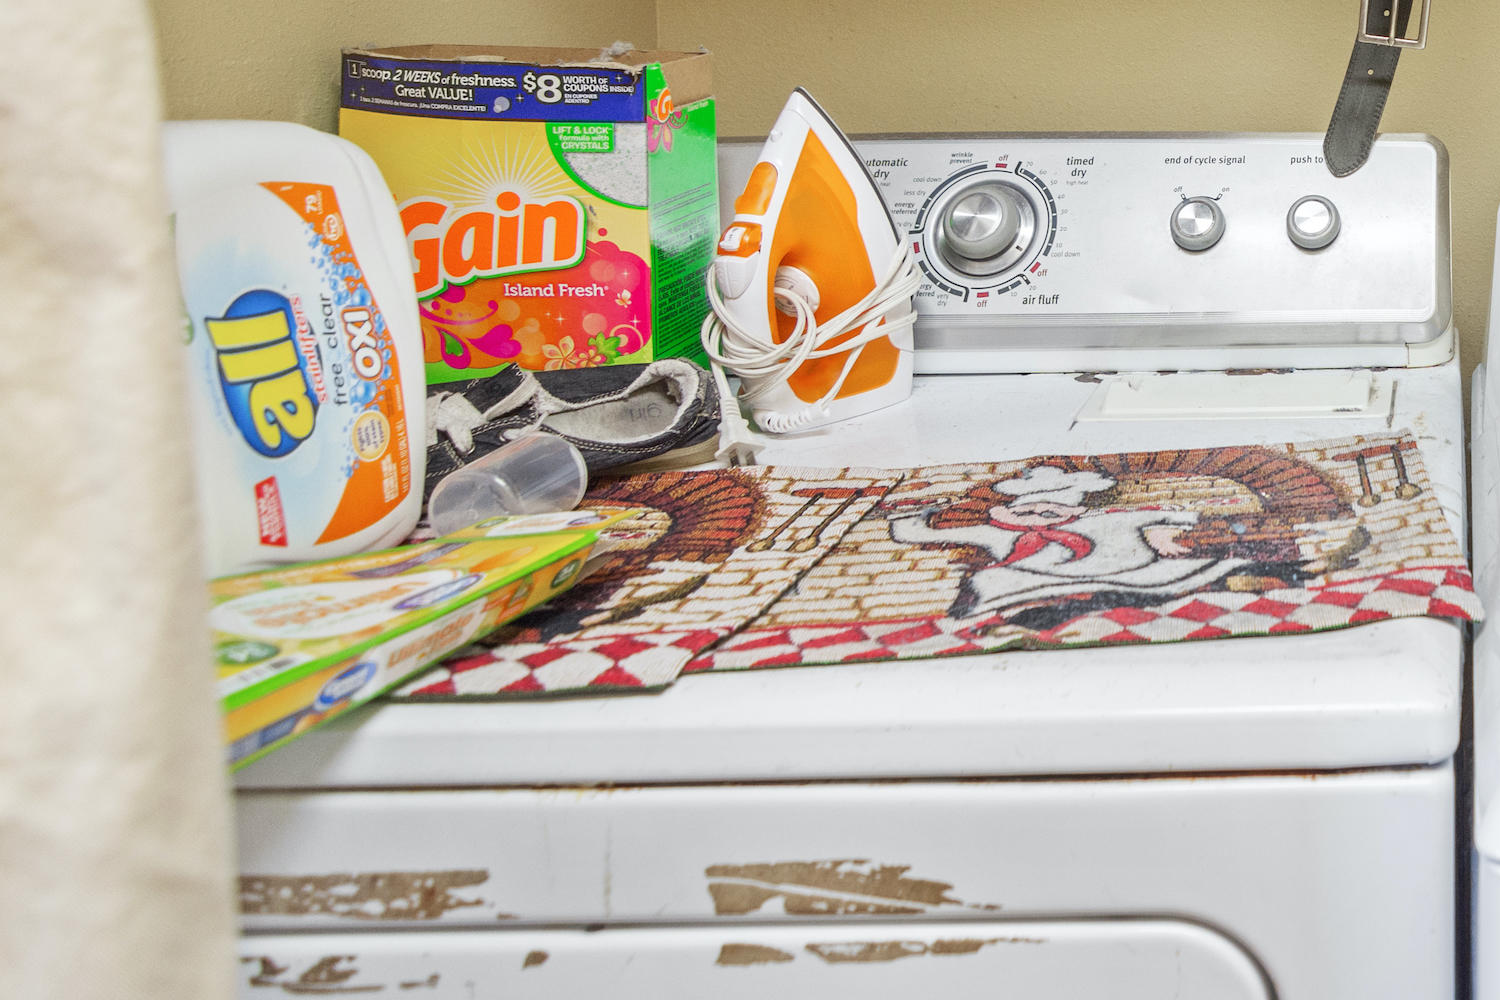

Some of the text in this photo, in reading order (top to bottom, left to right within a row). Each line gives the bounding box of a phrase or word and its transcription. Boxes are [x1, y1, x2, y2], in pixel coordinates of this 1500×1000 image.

[393, 70, 402, 81] 2
[403, 70, 442, 85] WEEKS
[441, 77, 451, 85] of
[451, 73, 518, 88] freshness.
[563, 76, 597, 85] WORTH
[395, 85, 474, 101] Great VALUE!
[563, 84, 609, 93] COUPONS
[552, 126, 572, 134] LIFT
[561, 141, 610, 150] CRYSTALS
[865, 157, 909, 167] utomatic
[950, 157, 973, 165] prevent
[998, 153, 1009, 162] off
[1066, 157, 1095, 166] timed
[1164, 155, 1246, 166] end of cycle signal
[1290, 155, 1324, 165] push to
[873, 169, 890, 180] dry
[1071, 167, 1087, 178] dry
[912, 175, 942, 183] cool down
[305, 194, 318, 214] 79
[894, 201, 915, 209] energy
[400, 191, 579, 293] Gain
[1037, 268, 1049, 278] off
[504, 283, 555, 297] Island
[937, 293, 950, 301] very
[1022, 293, 1061, 305] air fluff
[937, 299, 948, 308] dry
[976, 299, 988, 309] off
[289, 294, 329, 405] stainlifters
[319, 293, 350, 408] free clear
[342, 309, 384, 382] OXI
[205, 309, 316, 449] all
